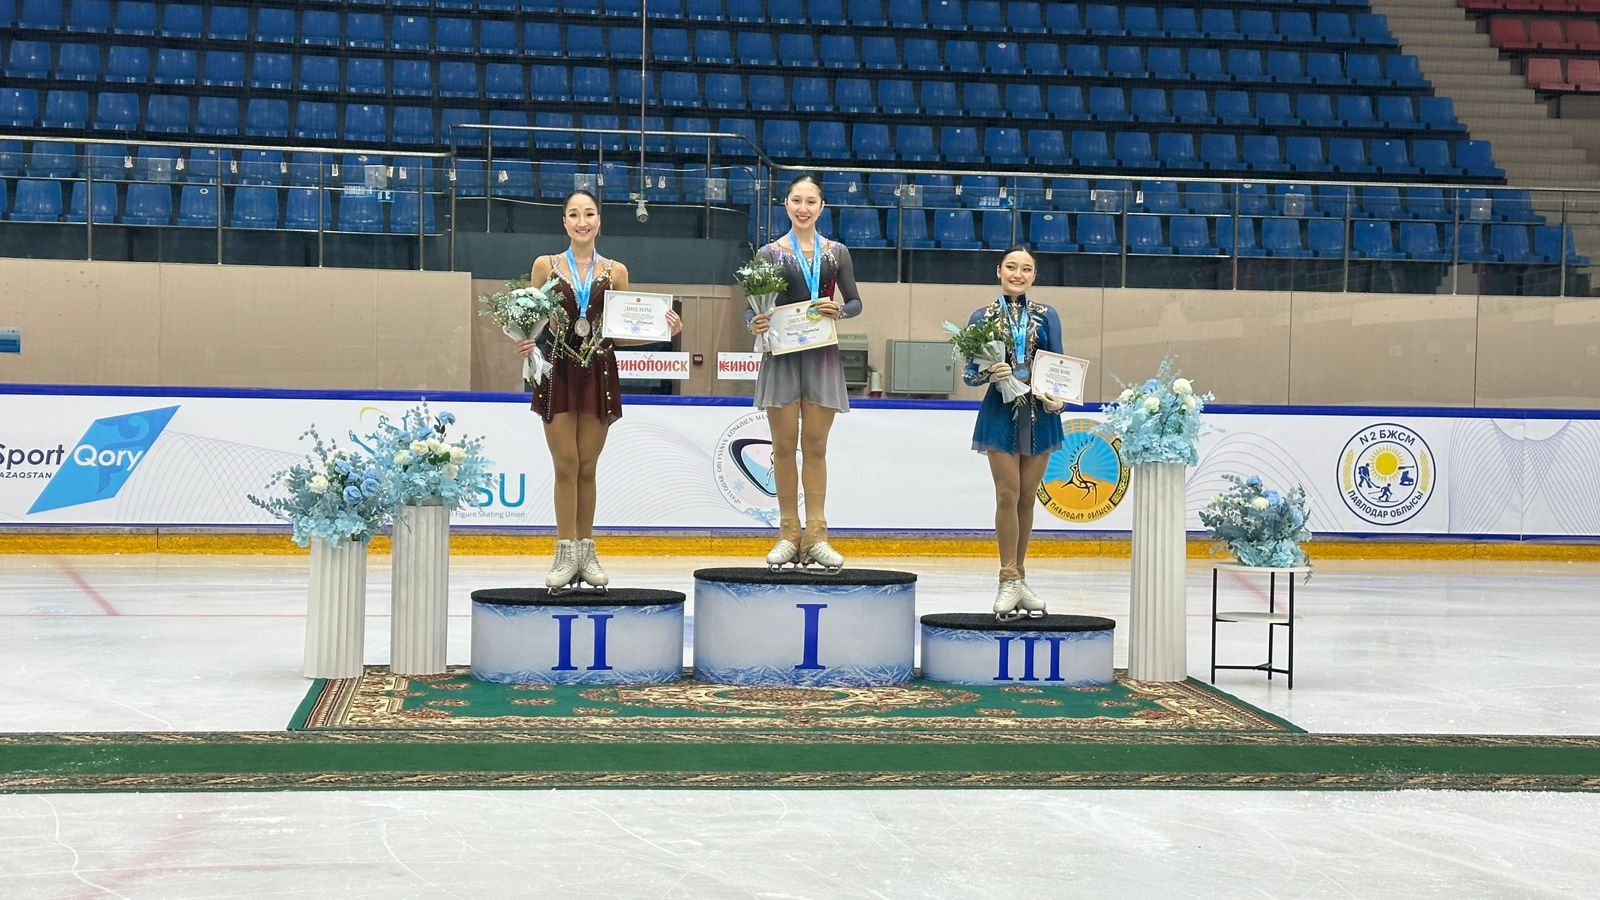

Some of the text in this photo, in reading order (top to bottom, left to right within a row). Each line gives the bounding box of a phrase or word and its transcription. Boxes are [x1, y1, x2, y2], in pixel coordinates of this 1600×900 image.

[1379, 430, 1415, 446] БЖСМ
[73, 444, 143, 471] Qory
[1348, 490, 1424, 518] ПАВЛОДАР ОБЛЫСЫ
[551, 614, 613, 671] II
[795, 604, 827, 669] I
[993, 636, 1065, 682] III
